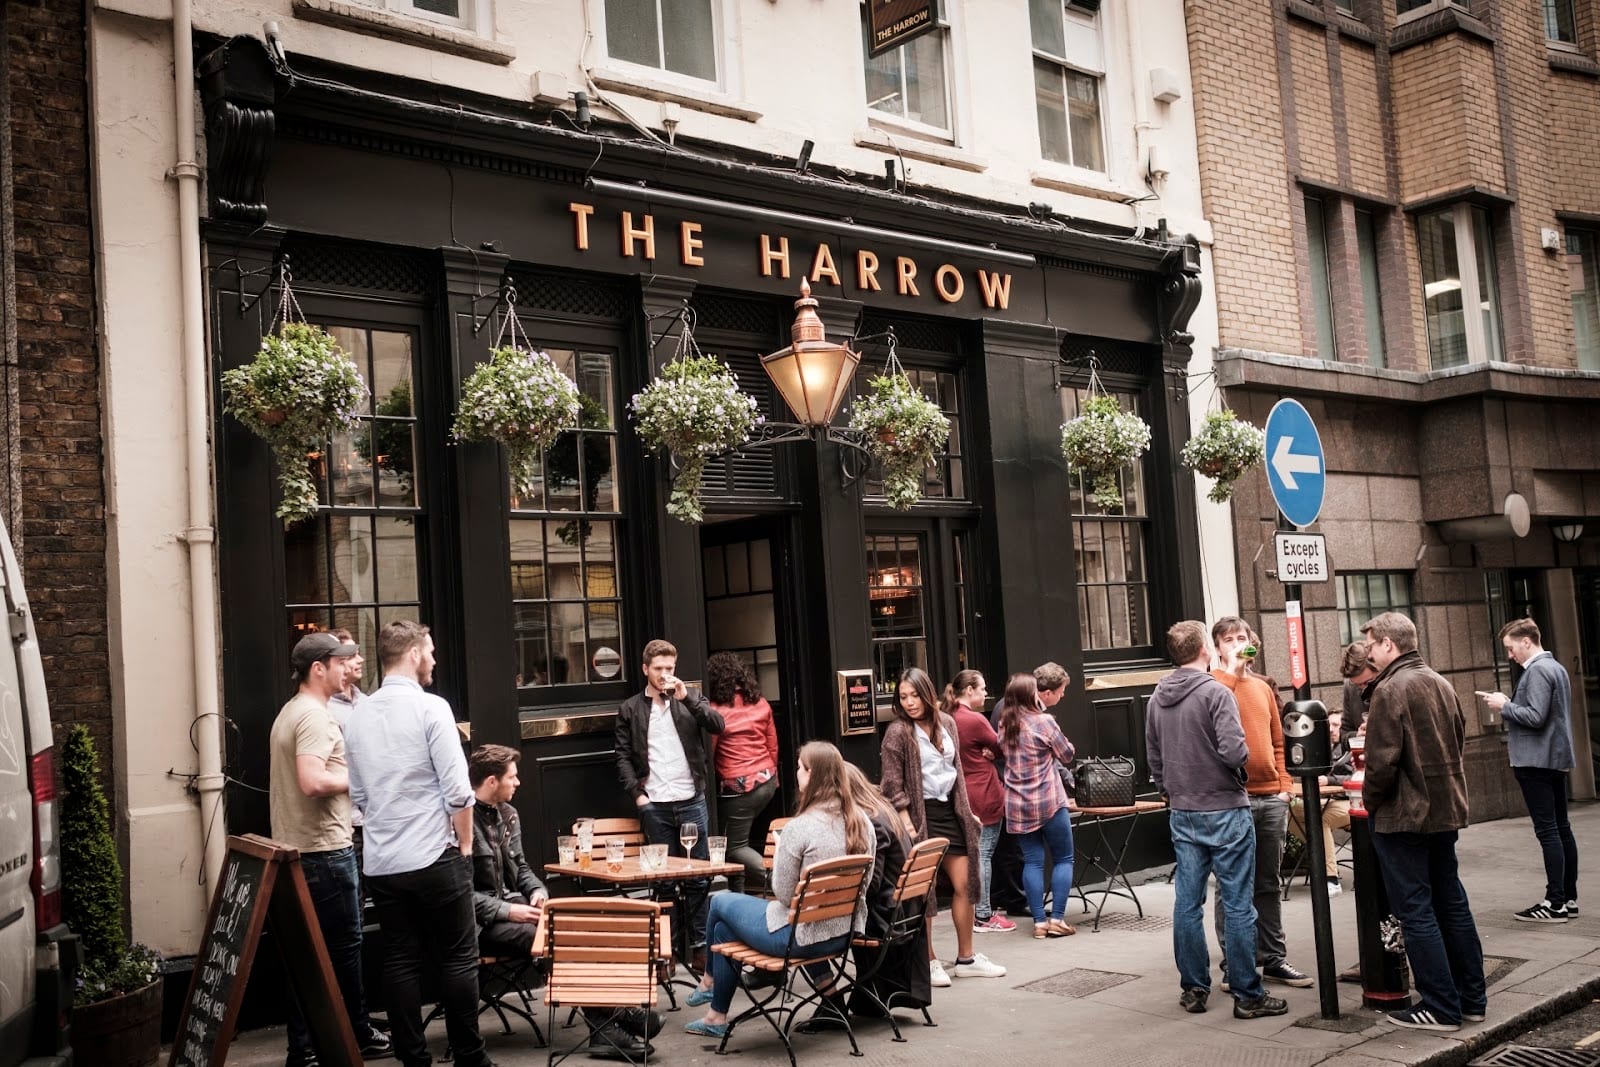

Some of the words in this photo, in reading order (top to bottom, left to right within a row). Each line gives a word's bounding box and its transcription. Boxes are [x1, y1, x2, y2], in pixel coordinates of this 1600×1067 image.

[877, 27, 892, 41] THE
[893, 10, 928, 34] HARROW
[568, 202, 704, 267] THE
[760, 234, 1012, 310] HARROW
[1283, 539, 1319, 559] Except
[1287, 559, 1319, 578] cycles
[1289, 621, 1298, 649] butts
[1292, 656, 1303, 679] gum
